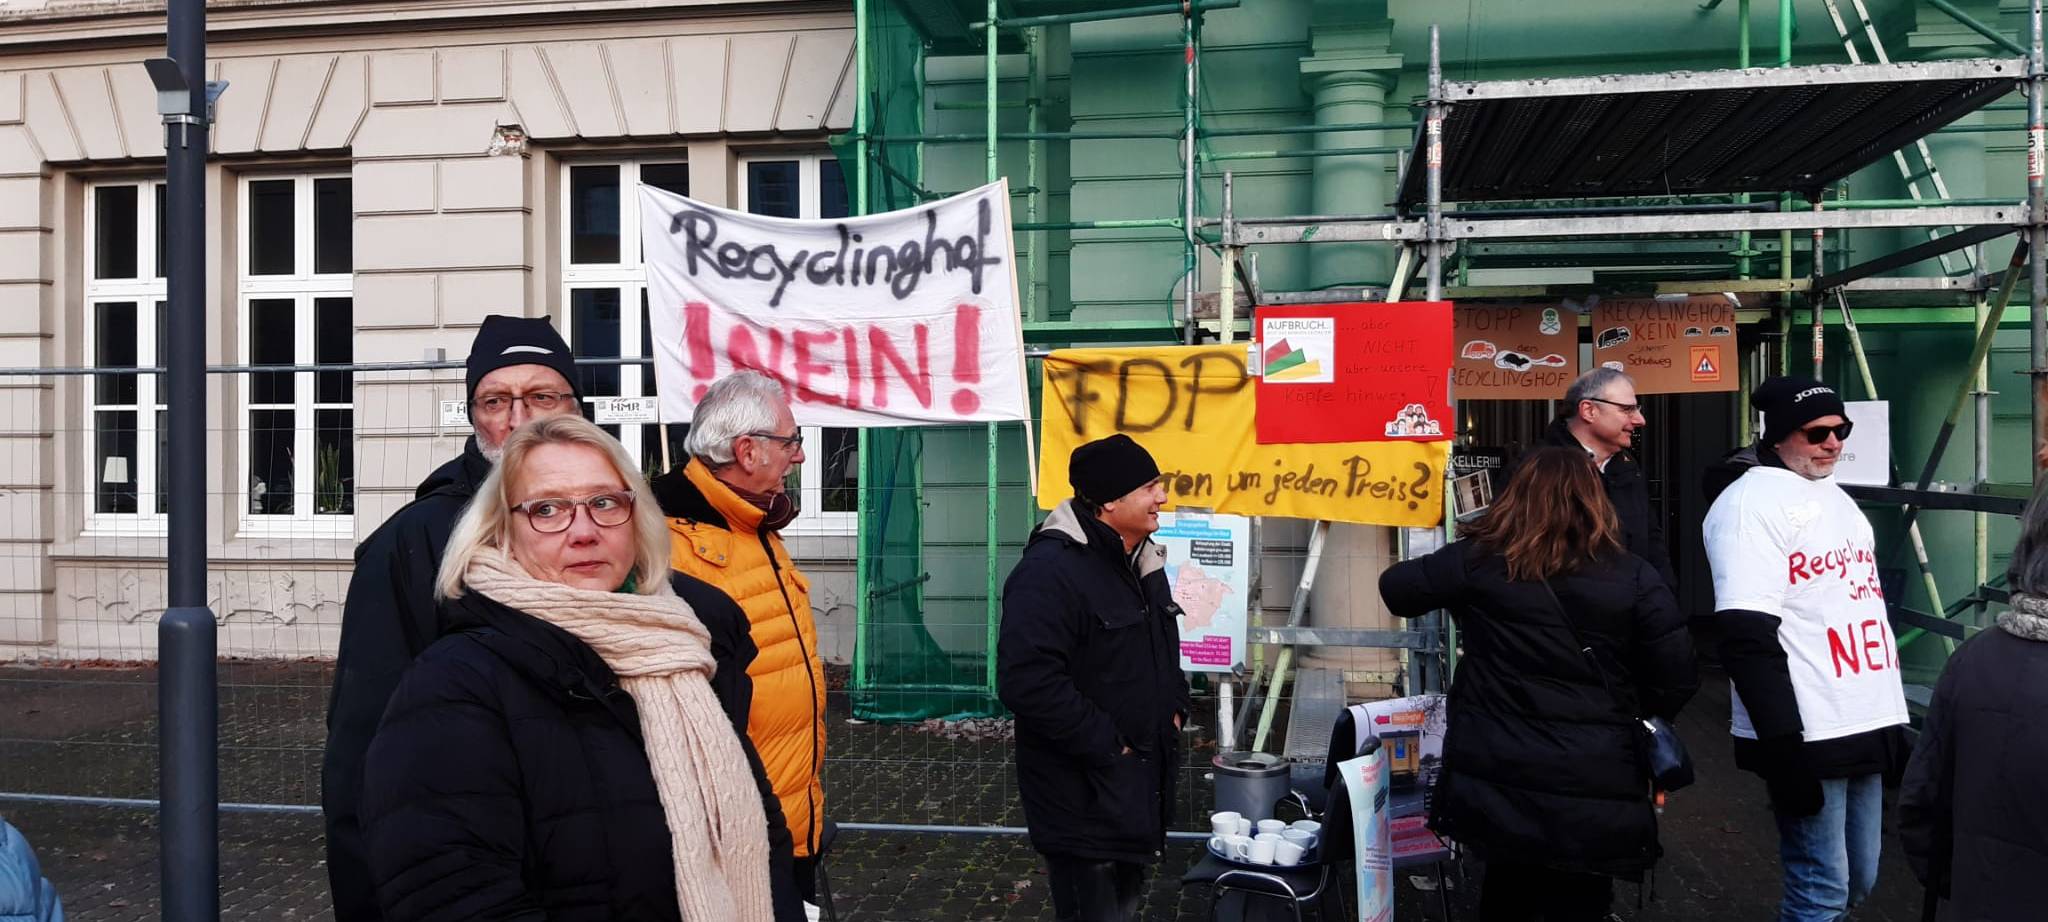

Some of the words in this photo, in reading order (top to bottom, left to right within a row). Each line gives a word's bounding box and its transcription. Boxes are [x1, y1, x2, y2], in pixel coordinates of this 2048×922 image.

[669, 198, 1002, 308] Recyclinghof
[1361, 317, 1392, 331] aber
[1634, 322, 1678, 341] KEIN
[1362, 338, 1417, 354] NICHT
[1517, 344, 1538, 353] den
[1452, 368, 1568, 388] RECYCLINGHOF
[1049, 351, 1250, 435] FDP
[1226, 470, 1262, 493] um
[1264, 459, 1338, 505] jeden
[1342, 455, 1431, 511] Preis?
[1788, 539, 1876, 585] Recycling
